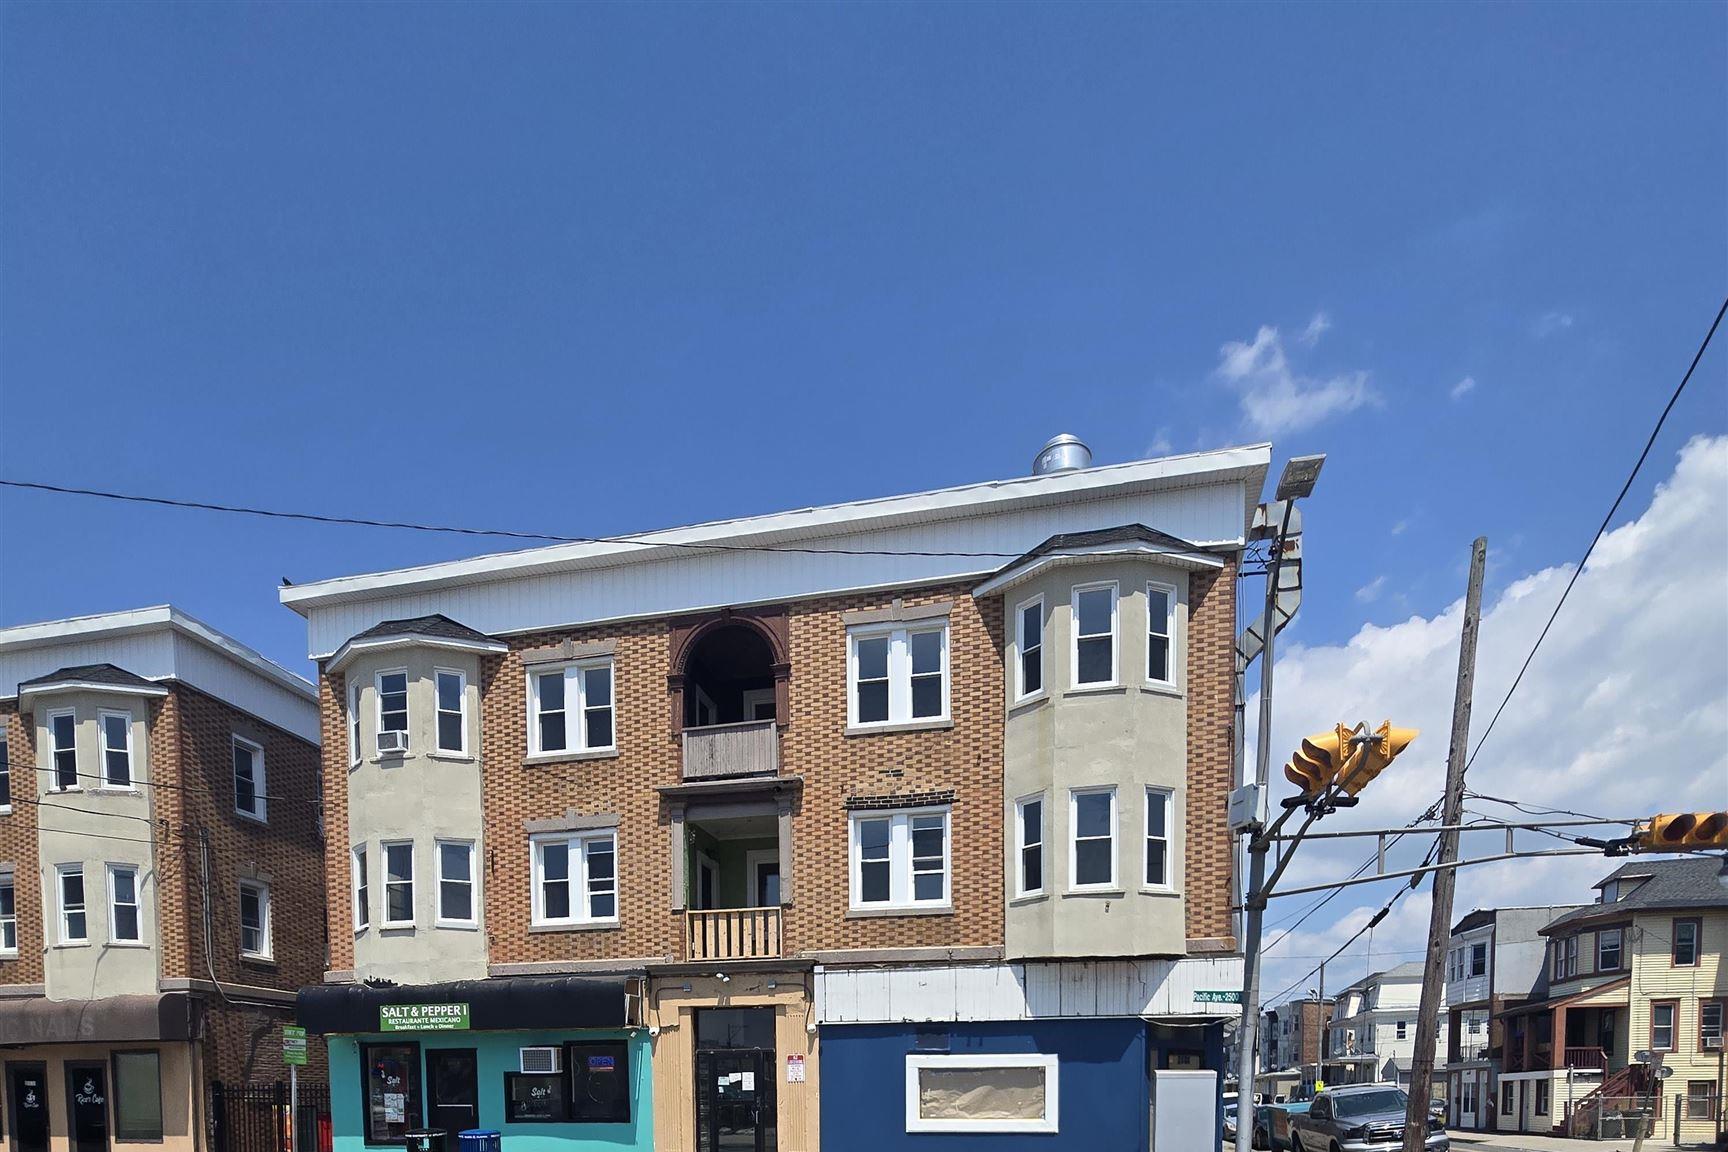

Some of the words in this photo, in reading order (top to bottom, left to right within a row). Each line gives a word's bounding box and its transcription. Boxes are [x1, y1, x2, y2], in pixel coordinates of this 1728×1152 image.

[382, 1007, 410, 1017] SALT
[411, 1006, 419, 1017] &
[421, 1005, 461, 1016] PEPPER
[588, 1056, 616, 1066] OPEN
[386, 1076, 401, 1085] Salt
[531, 1087, 546, 1098] Salt
